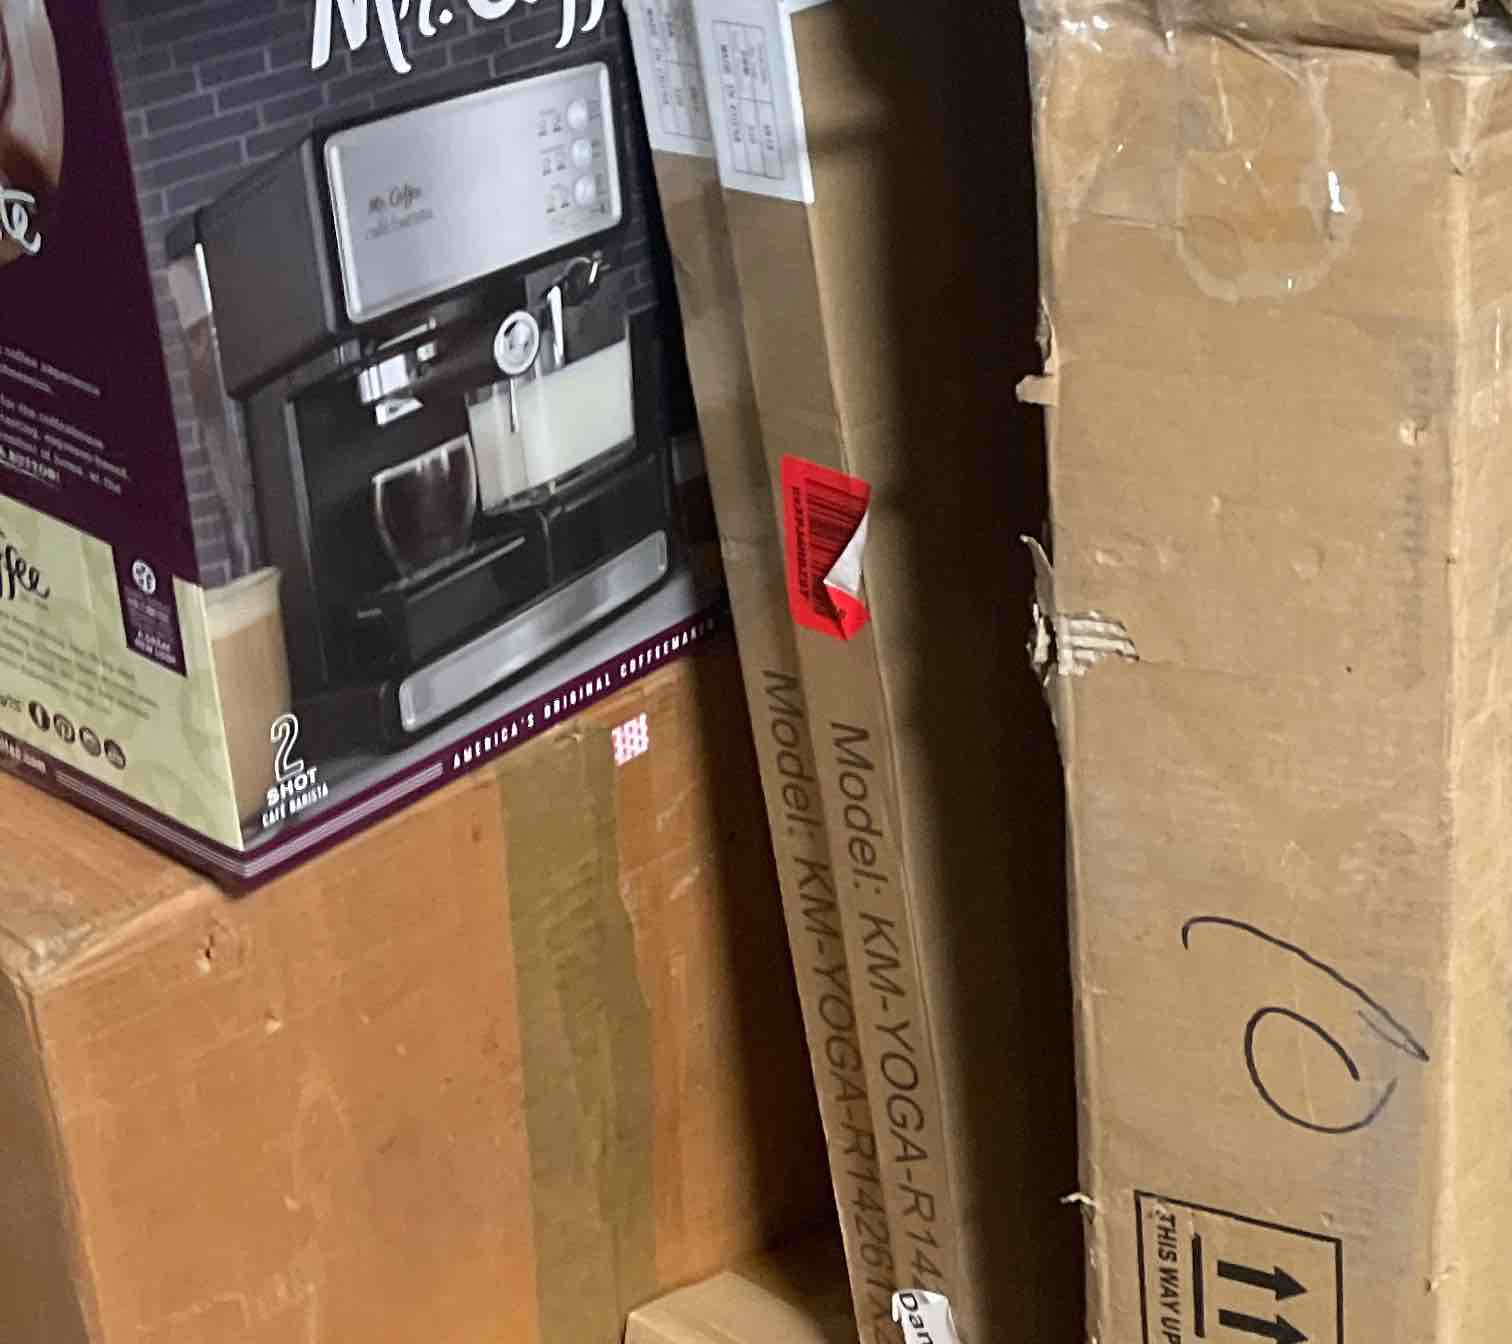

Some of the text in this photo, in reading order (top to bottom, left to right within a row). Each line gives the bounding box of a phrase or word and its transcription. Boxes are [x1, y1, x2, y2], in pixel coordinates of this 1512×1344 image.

[270, 713, 305, 783] 2
[453, 712, 535, 770] AMERICA'S
[544, 672, 611, 719] ORIGINAL
[266, 766, 318, 807] SHOT
[762, 668, 823, 850] Model:
[289, 782, 330, 815] BARISTA
[830, 720, 944, 1293] Model: KM-YOGA-R14
[1157, 1212, 1178, 1262] THIS
[1160, 1265, 1182, 1314] WAY
